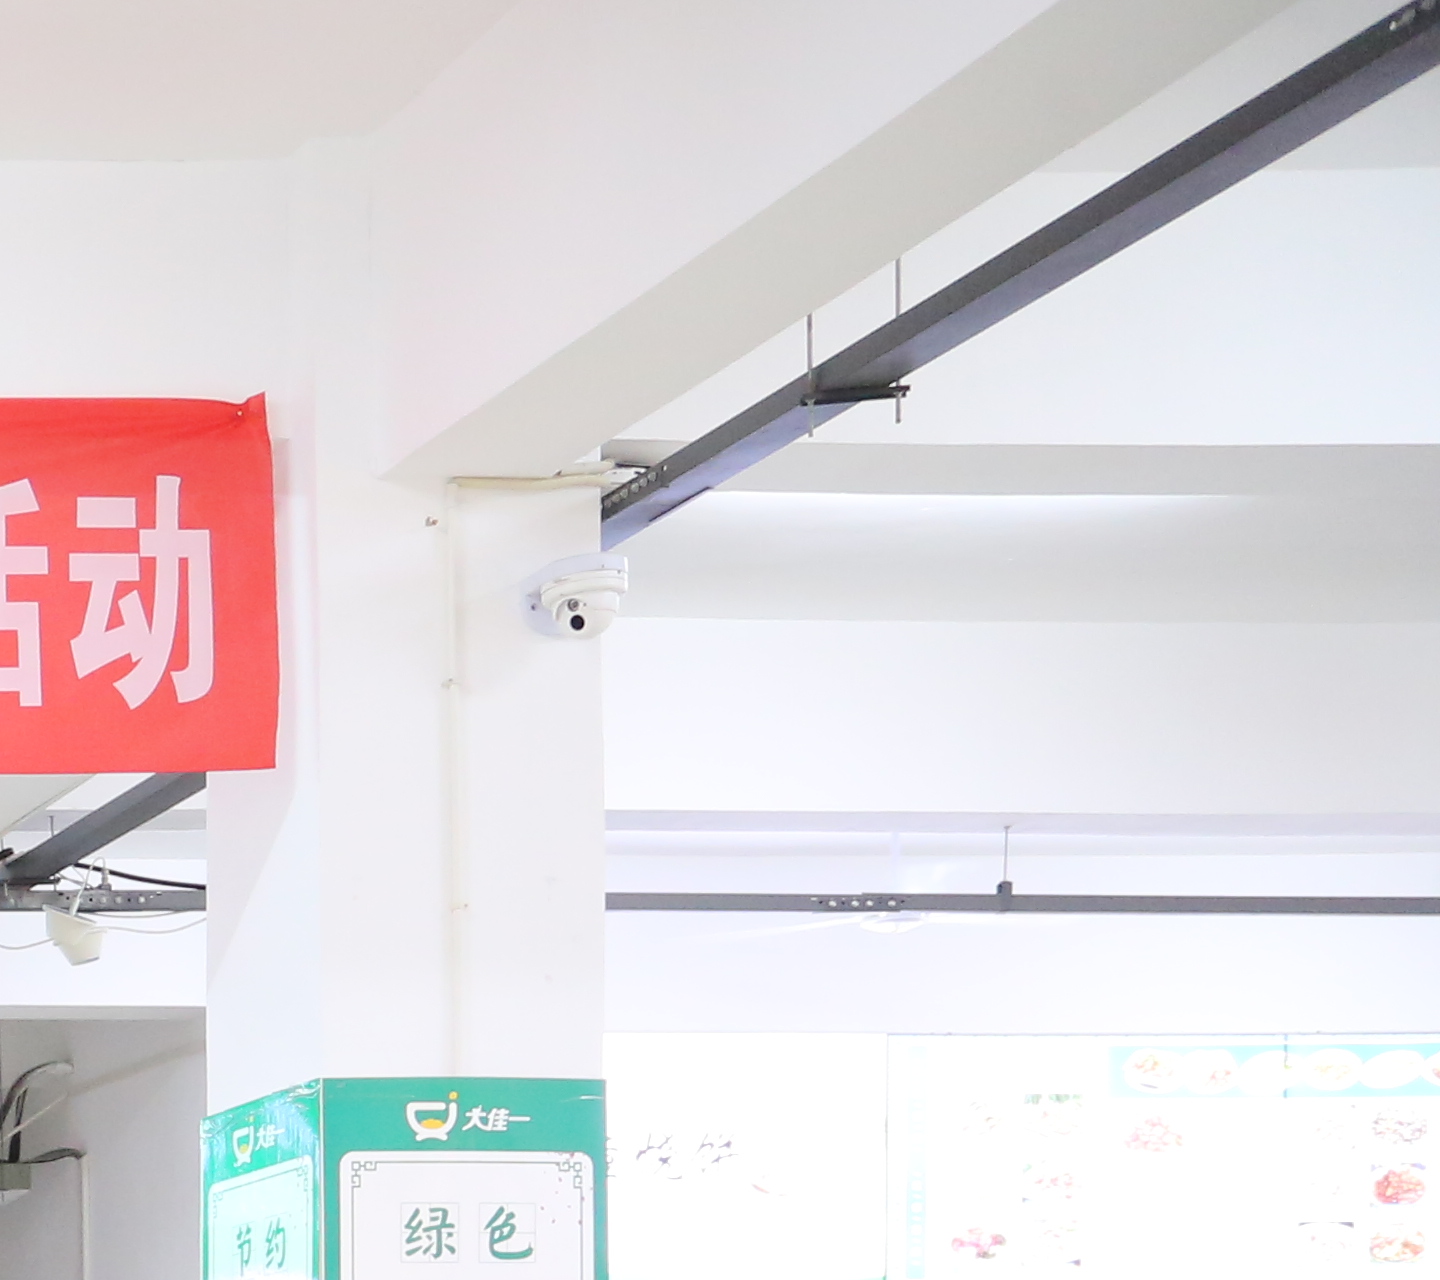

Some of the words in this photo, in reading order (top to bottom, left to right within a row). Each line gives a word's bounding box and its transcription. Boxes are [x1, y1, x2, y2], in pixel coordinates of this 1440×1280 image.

[462, 1105, 531, 1131] 大佳一
[237, 1217, 286, 1277] 节约
[404, 1206, 533, 1260] 绿色
